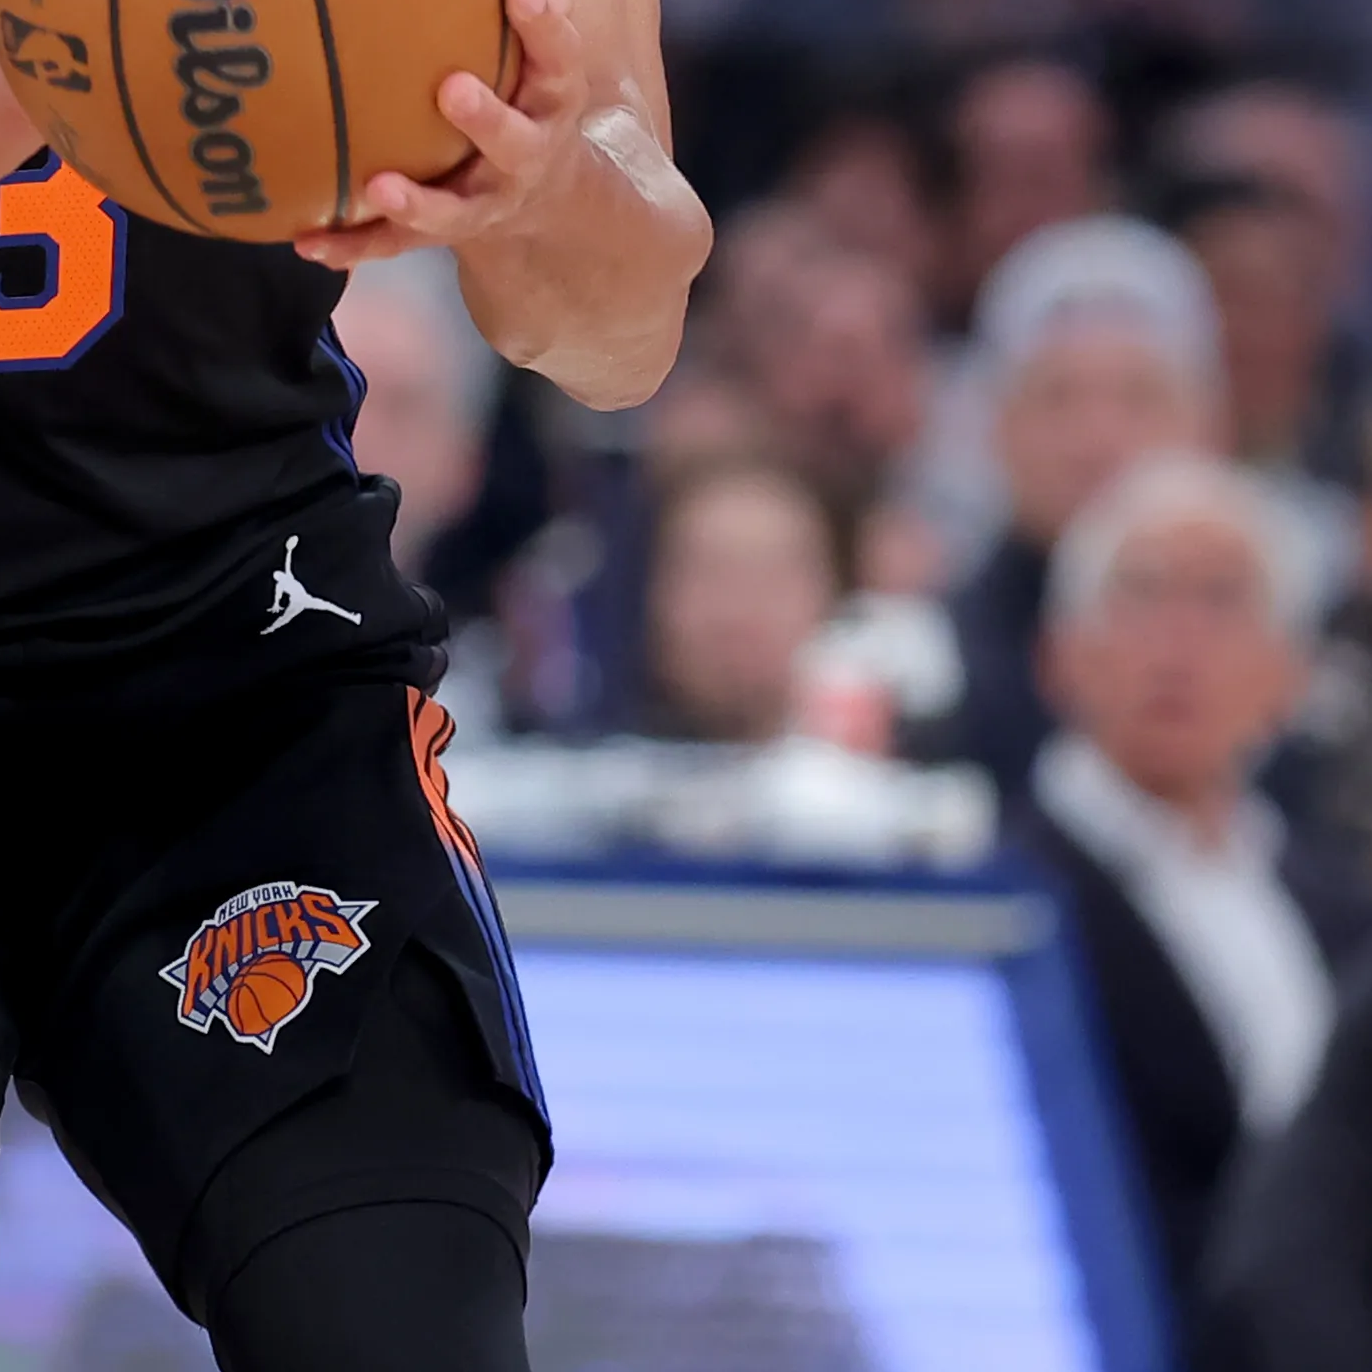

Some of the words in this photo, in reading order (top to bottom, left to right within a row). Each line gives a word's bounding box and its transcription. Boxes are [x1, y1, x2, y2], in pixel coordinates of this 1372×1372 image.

[218, 893, 249, 923] NEW
[252, 884, 295, 907] YORK
[182, 892, 362, 1018] KNICKS
